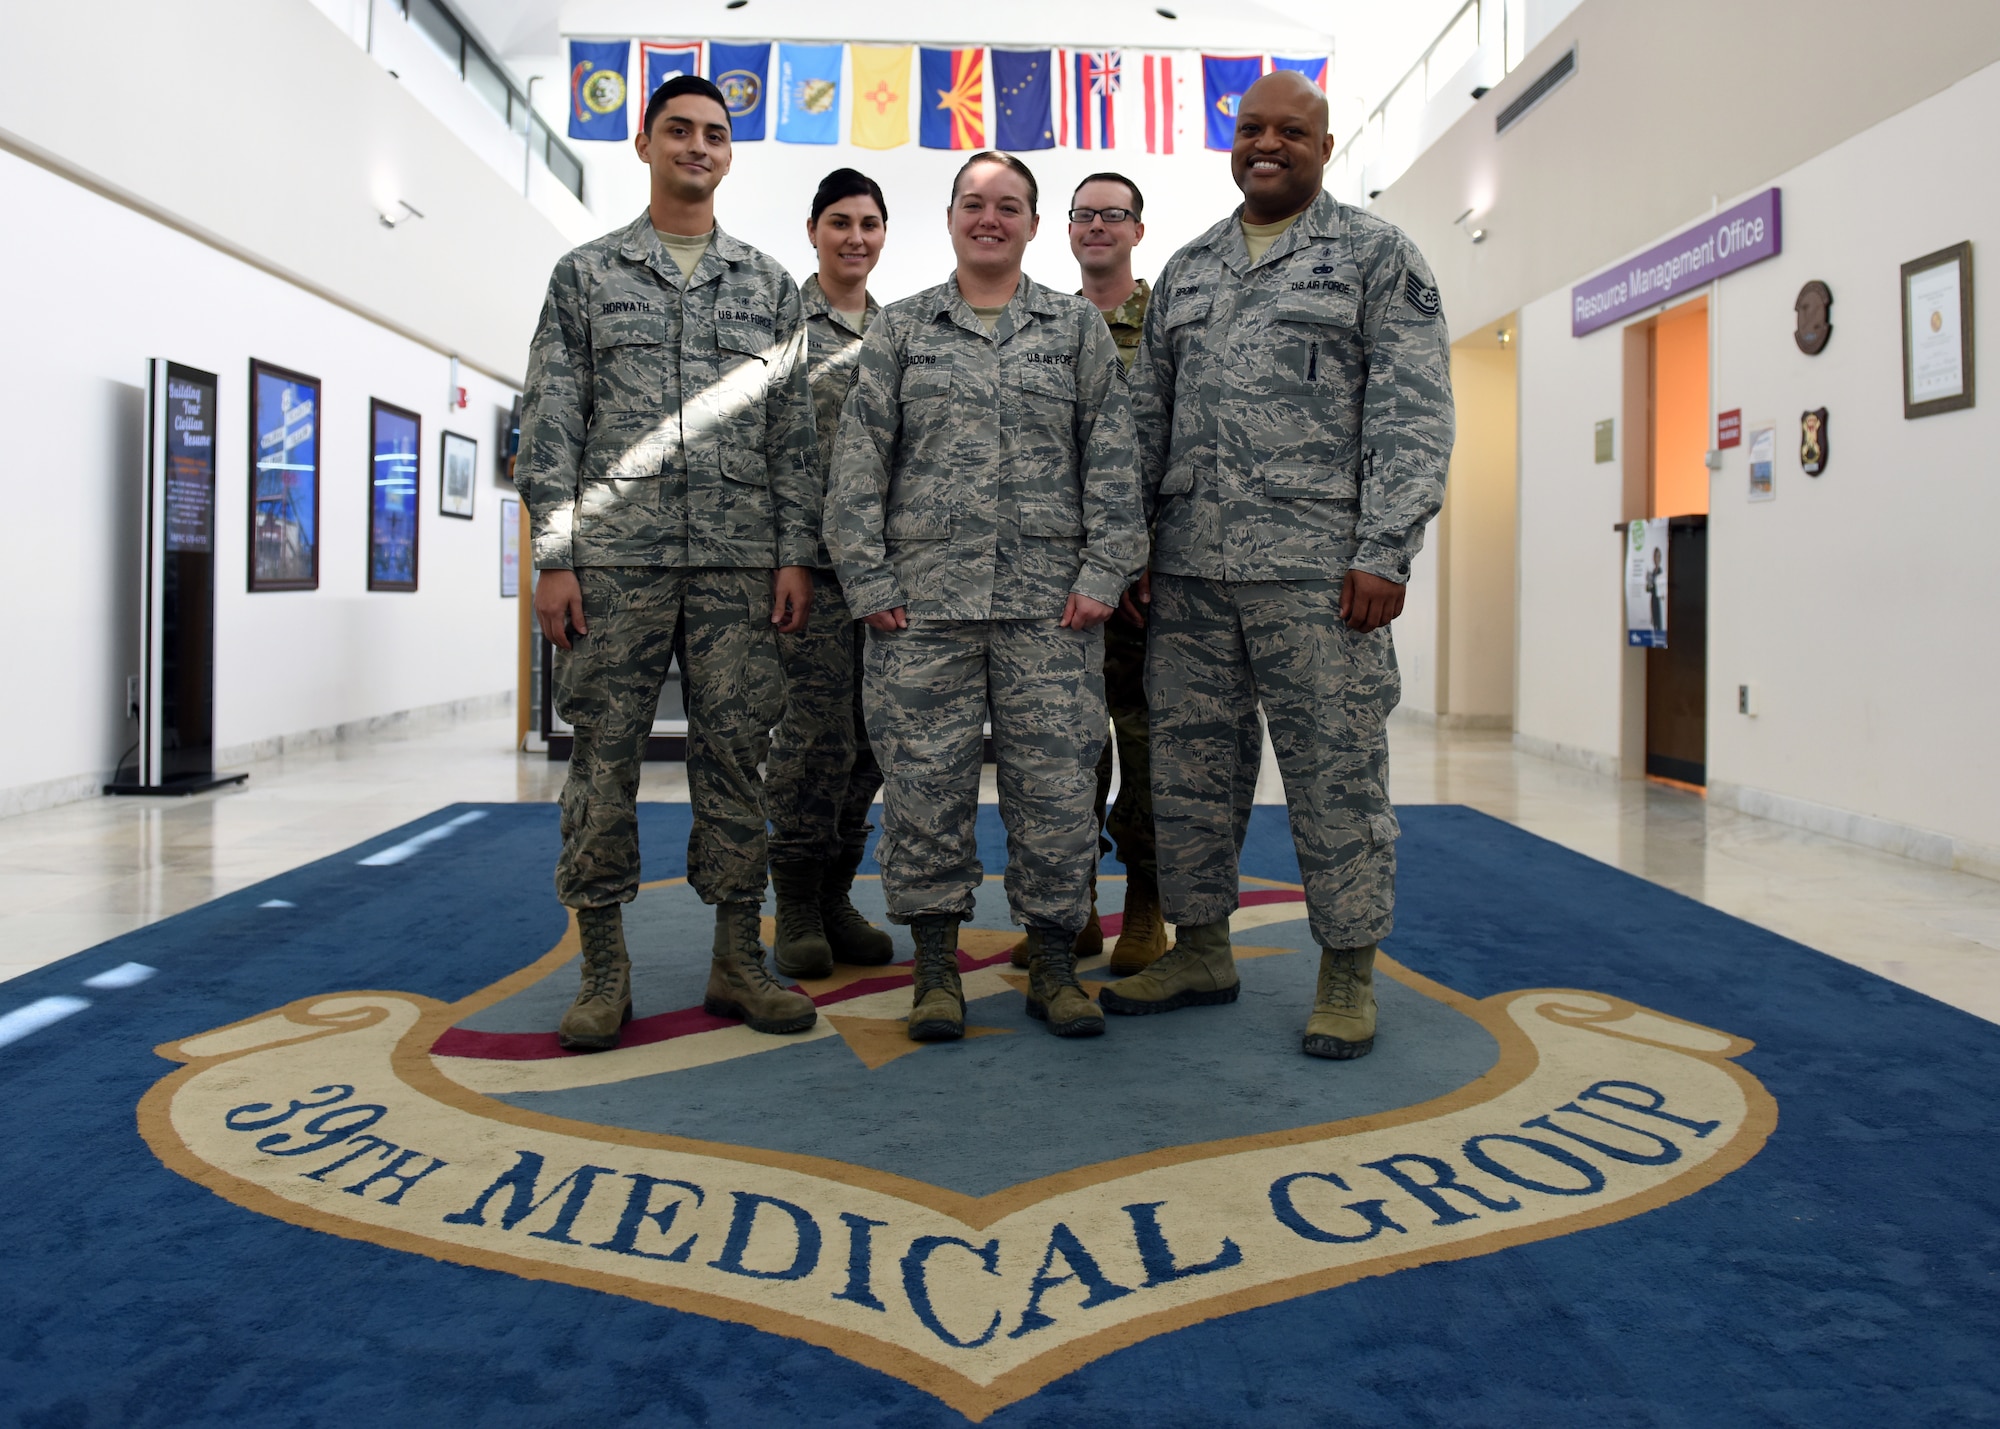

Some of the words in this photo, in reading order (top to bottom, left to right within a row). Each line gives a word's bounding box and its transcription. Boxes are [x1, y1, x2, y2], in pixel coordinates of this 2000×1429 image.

[1575, 280, 1628, 323] Resource
[1629, 234, 1715, 298] Management
[1717, 216, 1764, 259] Office
[1306, 280, 1320, 290] AIR
[1322, 280, 1350, 294] FORCE
[602, 300, 650, 315] HORVATH
[735, 311, 749, 322] AIR
[751, 313, 772, 330] FORCE
[168, 383, 202, 404] Building
[182, 400, 201, 415] Your
[174, 414, 204, 431] Civilian
[182, 430, 212, 447] Resume
[225, 1083, 449, 1206] 39TH
[442, 1150, 1243, 1349] MEDICAL
[1268, 1078, 1722, 1245] GROUP
